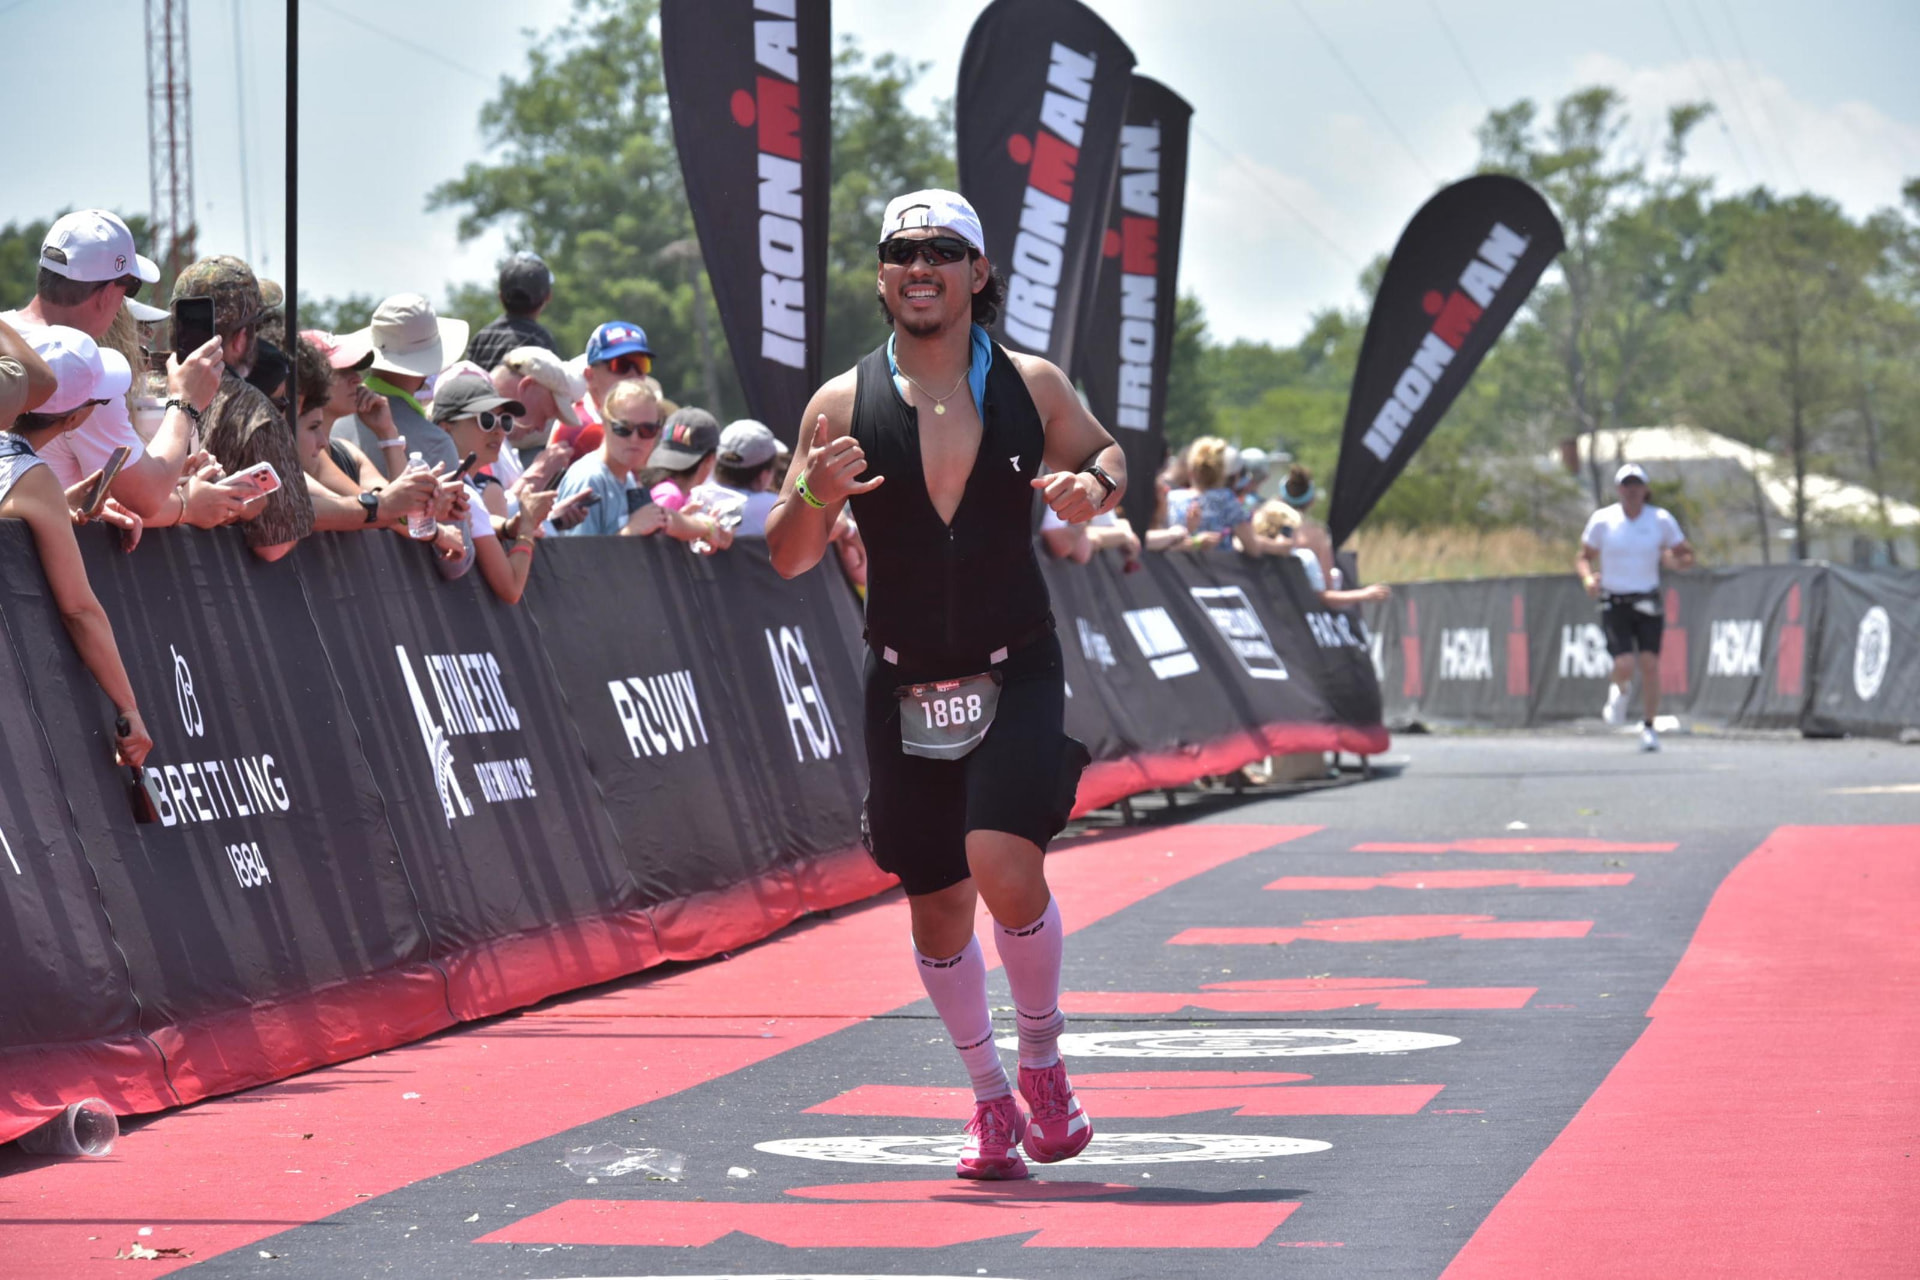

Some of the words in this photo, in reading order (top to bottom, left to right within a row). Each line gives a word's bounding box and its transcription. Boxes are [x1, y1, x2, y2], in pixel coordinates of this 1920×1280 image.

[1005, 41, 1097, 353] IRONMAN
[1102, 124, 1160, 432] IRONMAN
[1361, 221, 1529, 463] IRONMAN
[424, 651, 520, 736] ATHLETIC
[607, 669, 709, 758] ROUVY
[921, 694, 982, 729] 1868
[147, 753, 290, 827] BREITLING
[473, 759, 523, 803] BREWING
[225, 842, 272, 888] 1884
[921, 955, 963, 968] cep
[1004, 921, 1045, 937] cep
